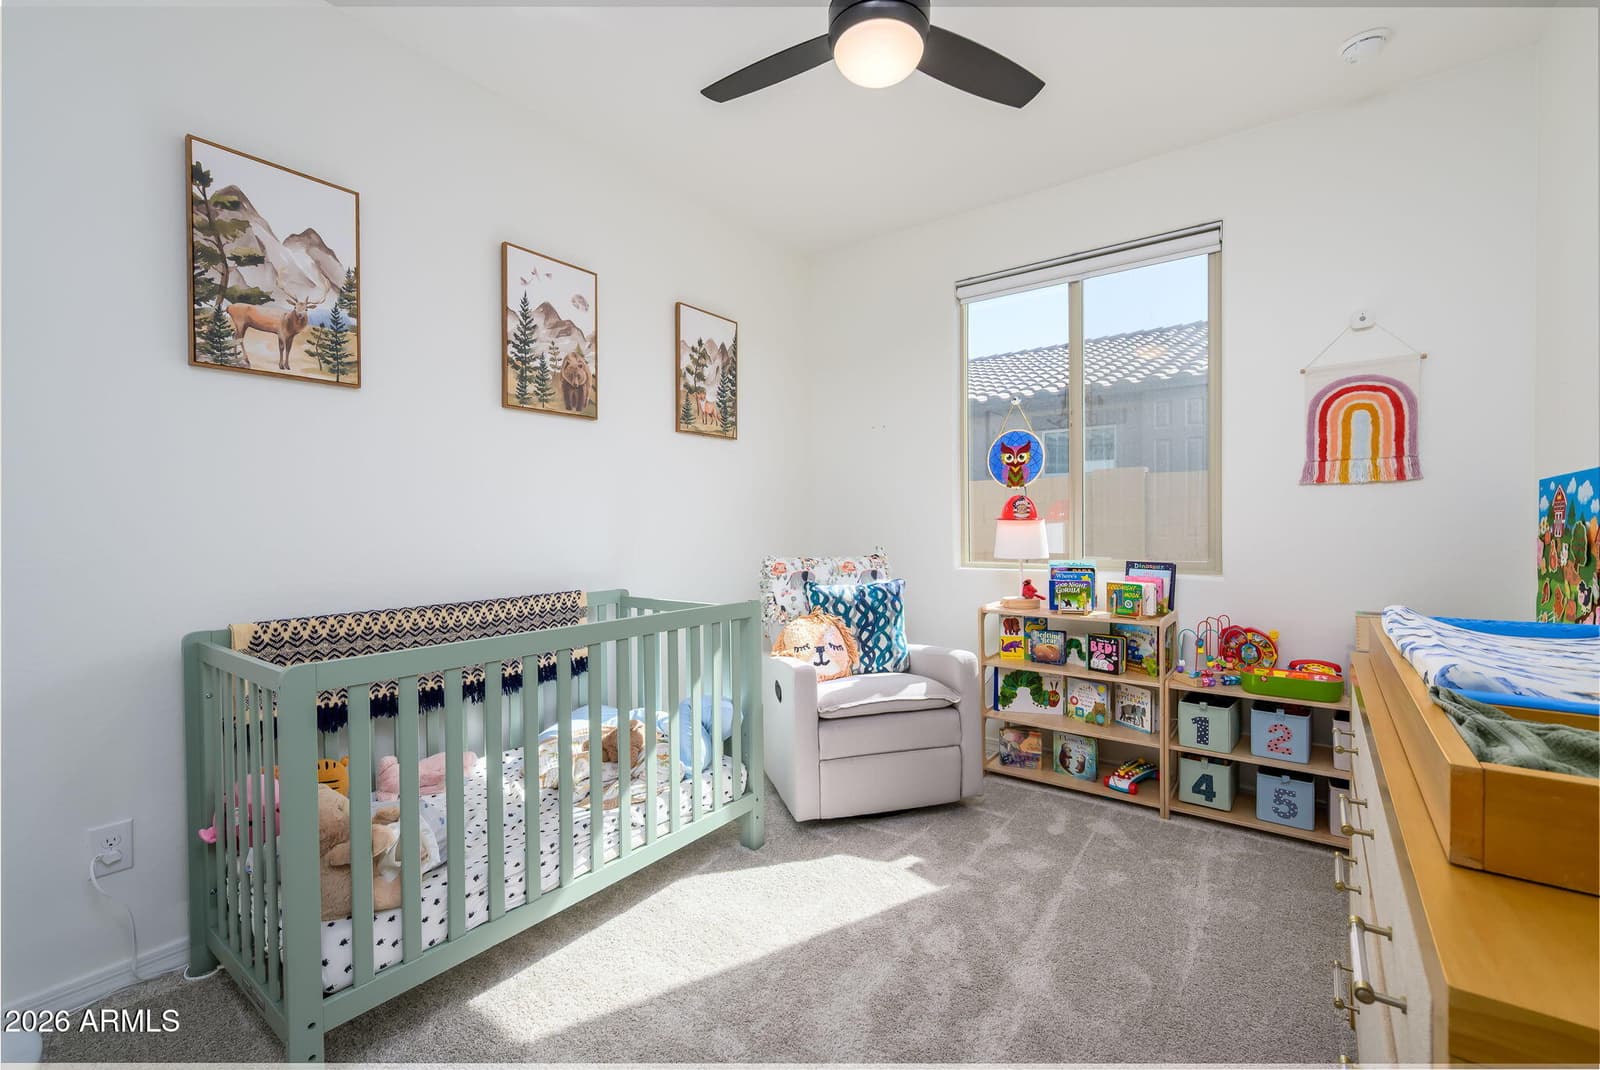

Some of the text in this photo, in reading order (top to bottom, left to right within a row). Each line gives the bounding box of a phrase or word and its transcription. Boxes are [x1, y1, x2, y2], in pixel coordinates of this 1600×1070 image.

[1090, 640, 1117, 656] BED!
[1191, 716, 1209, 745] 1
[1267, 723, 1293, 756] 2
[1191, 773, 1217, 803] 4
[1272, 788, 1298, 819] 5
